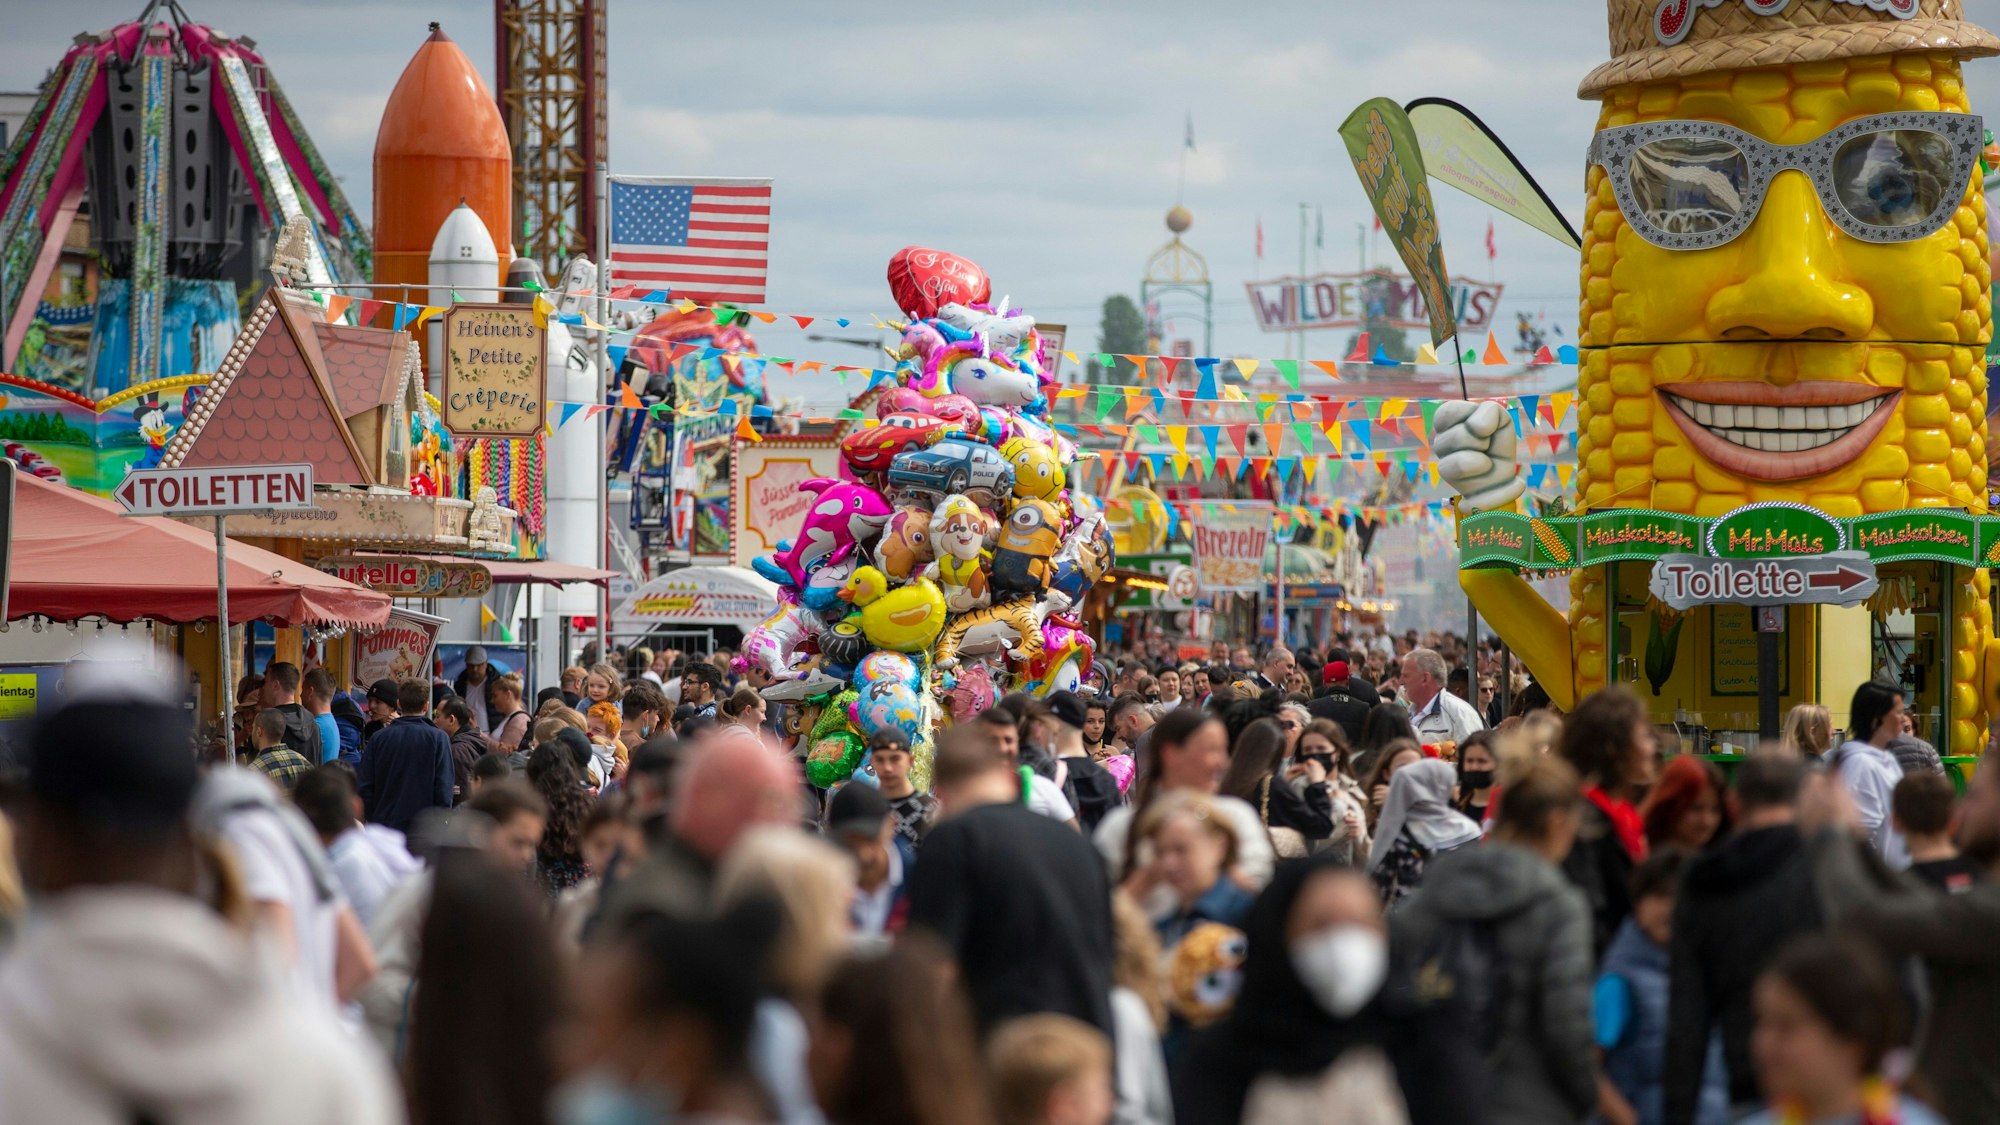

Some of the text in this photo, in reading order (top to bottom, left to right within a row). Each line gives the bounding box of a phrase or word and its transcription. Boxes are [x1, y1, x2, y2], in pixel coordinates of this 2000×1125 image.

[1382, 152, 1412, 232] auf
[941, 258, 972, 281] Lo
[923, 275, 959, 299] You
[1256, 280, 1491, 326] WILDE MUS
[457, 320, 535, 338] Heinen's
[467, 347, 523, 365] Petite
[450, 387, 537, 414] Crêperie
[139, 473, 305, 508] TOILETTEN
[767, 497, 814, 528] Paradi
[1196, 525, 1268, 558] Brezeln
[1586, 523, 1693, 549] Maiskolben
[1858, 523, 1969, 548] Maiskolben
[1667, 563, 1804, 598] Toilette
[358, 627, 429, 662] Pommes
[0, 686, 36, 699] ientag
